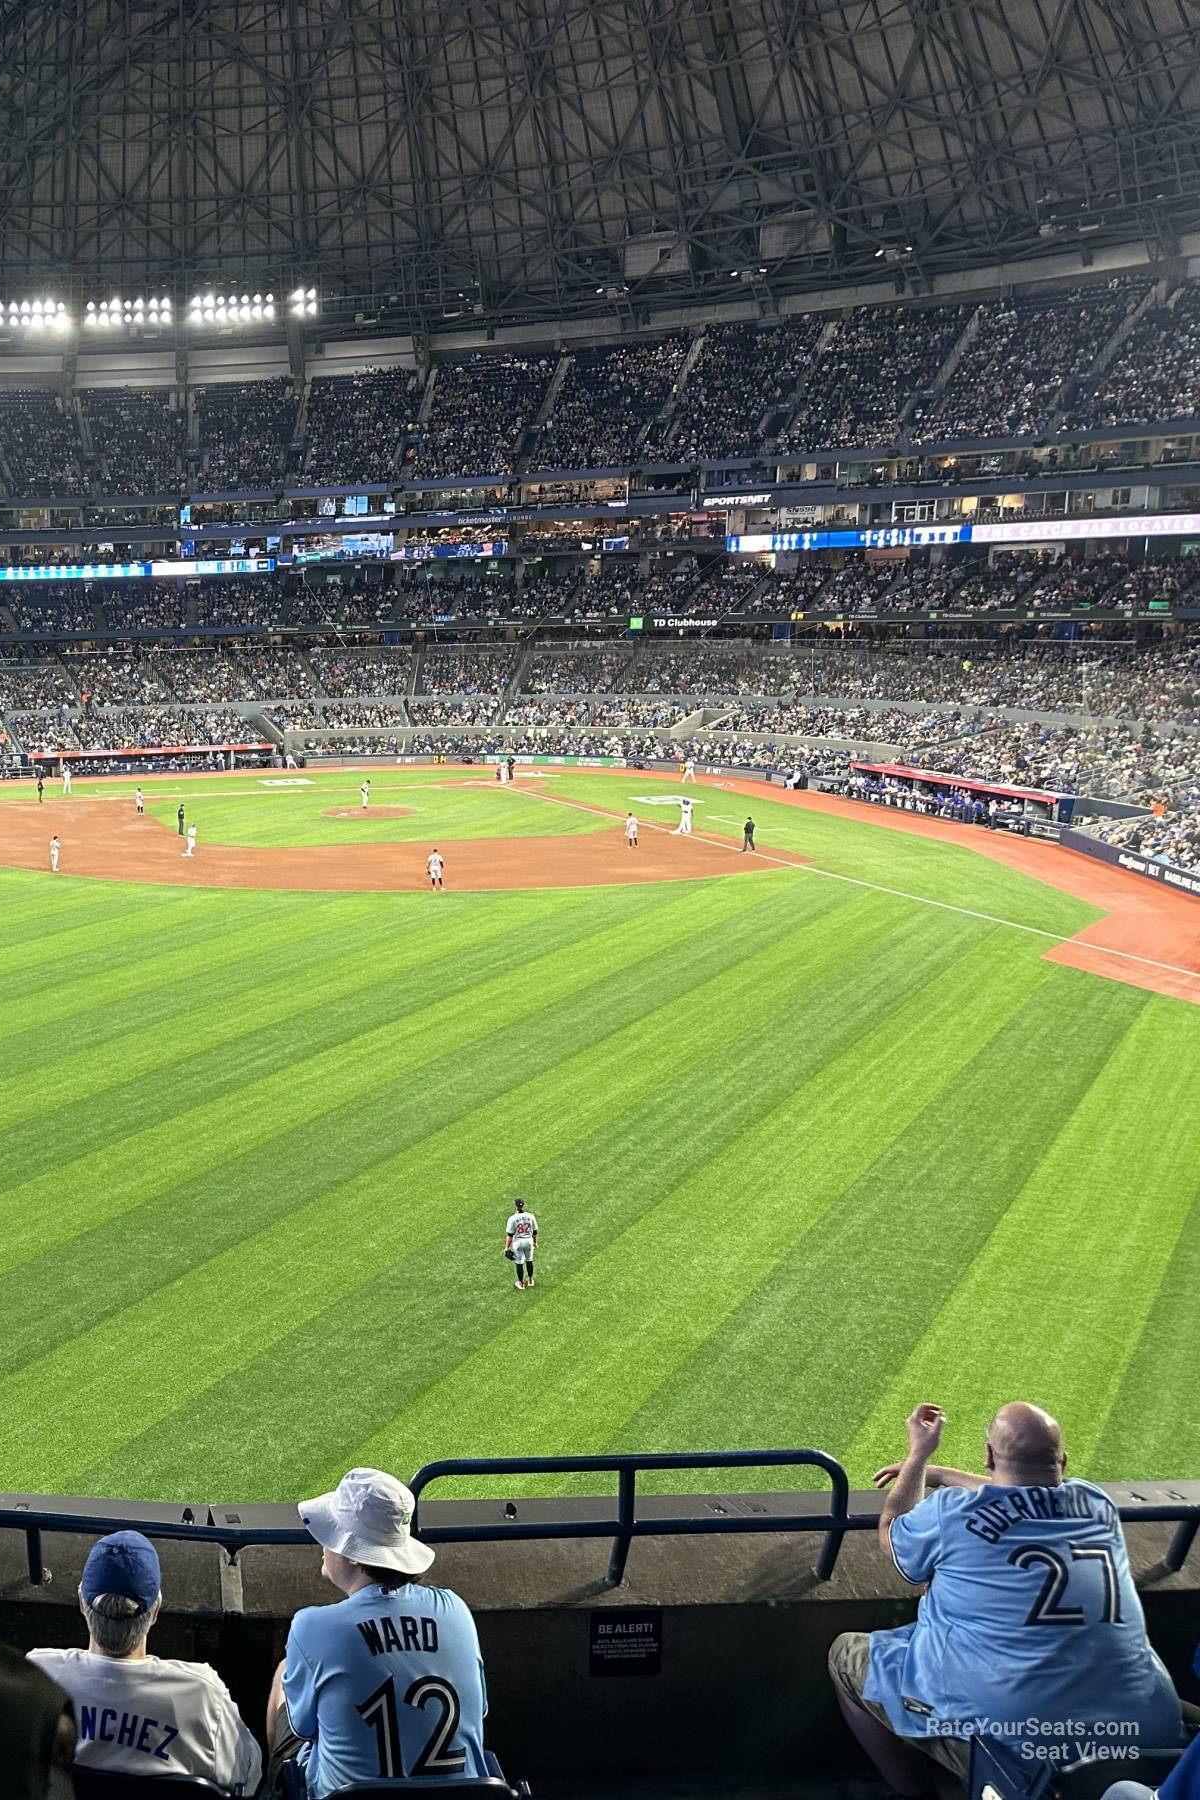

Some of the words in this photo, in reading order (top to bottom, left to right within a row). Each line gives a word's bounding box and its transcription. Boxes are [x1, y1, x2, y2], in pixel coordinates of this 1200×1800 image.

[703, 494, 772, 507] SPORTSNET
[458, 516, 504, 525] ticketmaster
[1019, 524, 1072, 537] CATCH
[1120, 516, 1195, 532] LOCATED
[653, 618, 666, 627] TD
[667, 618, 718, 626] Clubhouse
[1148, 864, 1160, 876] BET
[516, 1223, 531, 1234] 82
[965, 1486, 1094, 1544] GUERRERO
[1006, 1542, 1127, 1626] 27
[356, 1615, 440, 1656] WARD
[598, 1624, 613, 1634] BE
[614, 1623, 653, 1633] ALERT!
[81, 1705, 180, 1762] NCHEZ
[355, 1674, 466, 1778] 12
